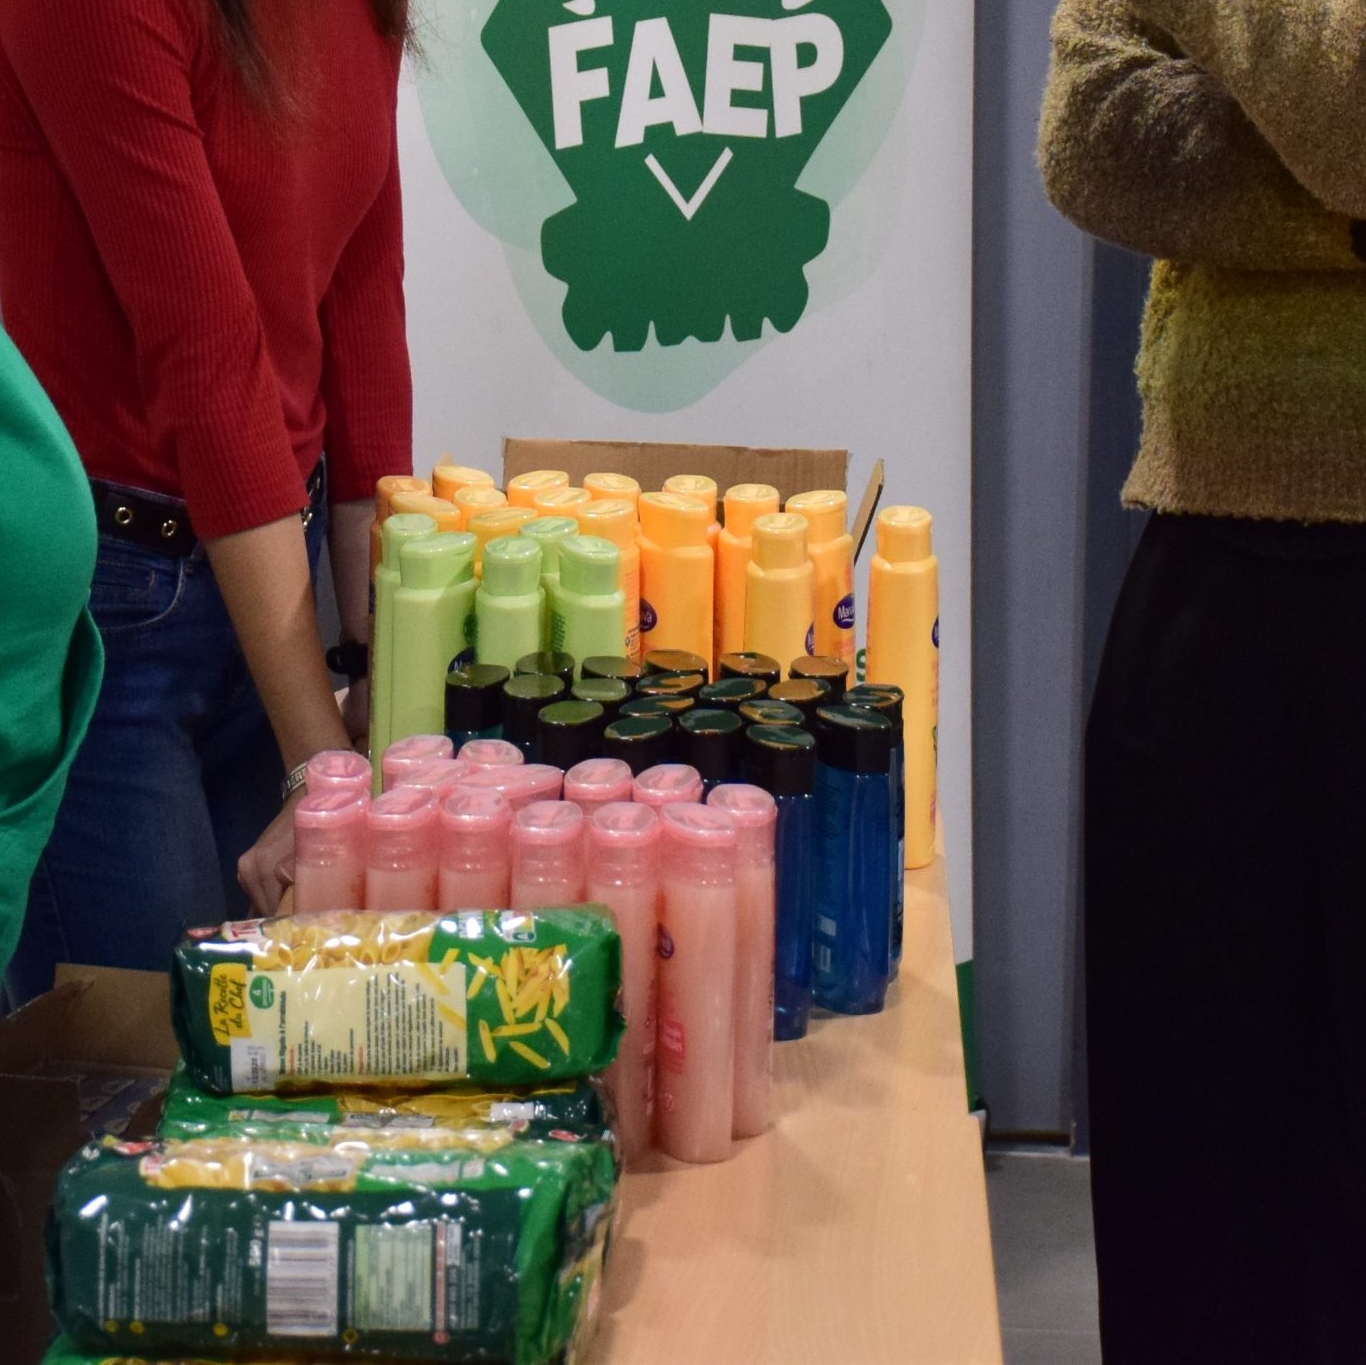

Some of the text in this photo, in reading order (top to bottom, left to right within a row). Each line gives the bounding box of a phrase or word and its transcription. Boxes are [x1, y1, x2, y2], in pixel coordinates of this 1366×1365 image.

[547, 11, 844, 151] FAEP
[213, 973, 230, 1036] La Recette
[229, 978, 247, 1009] Chef
